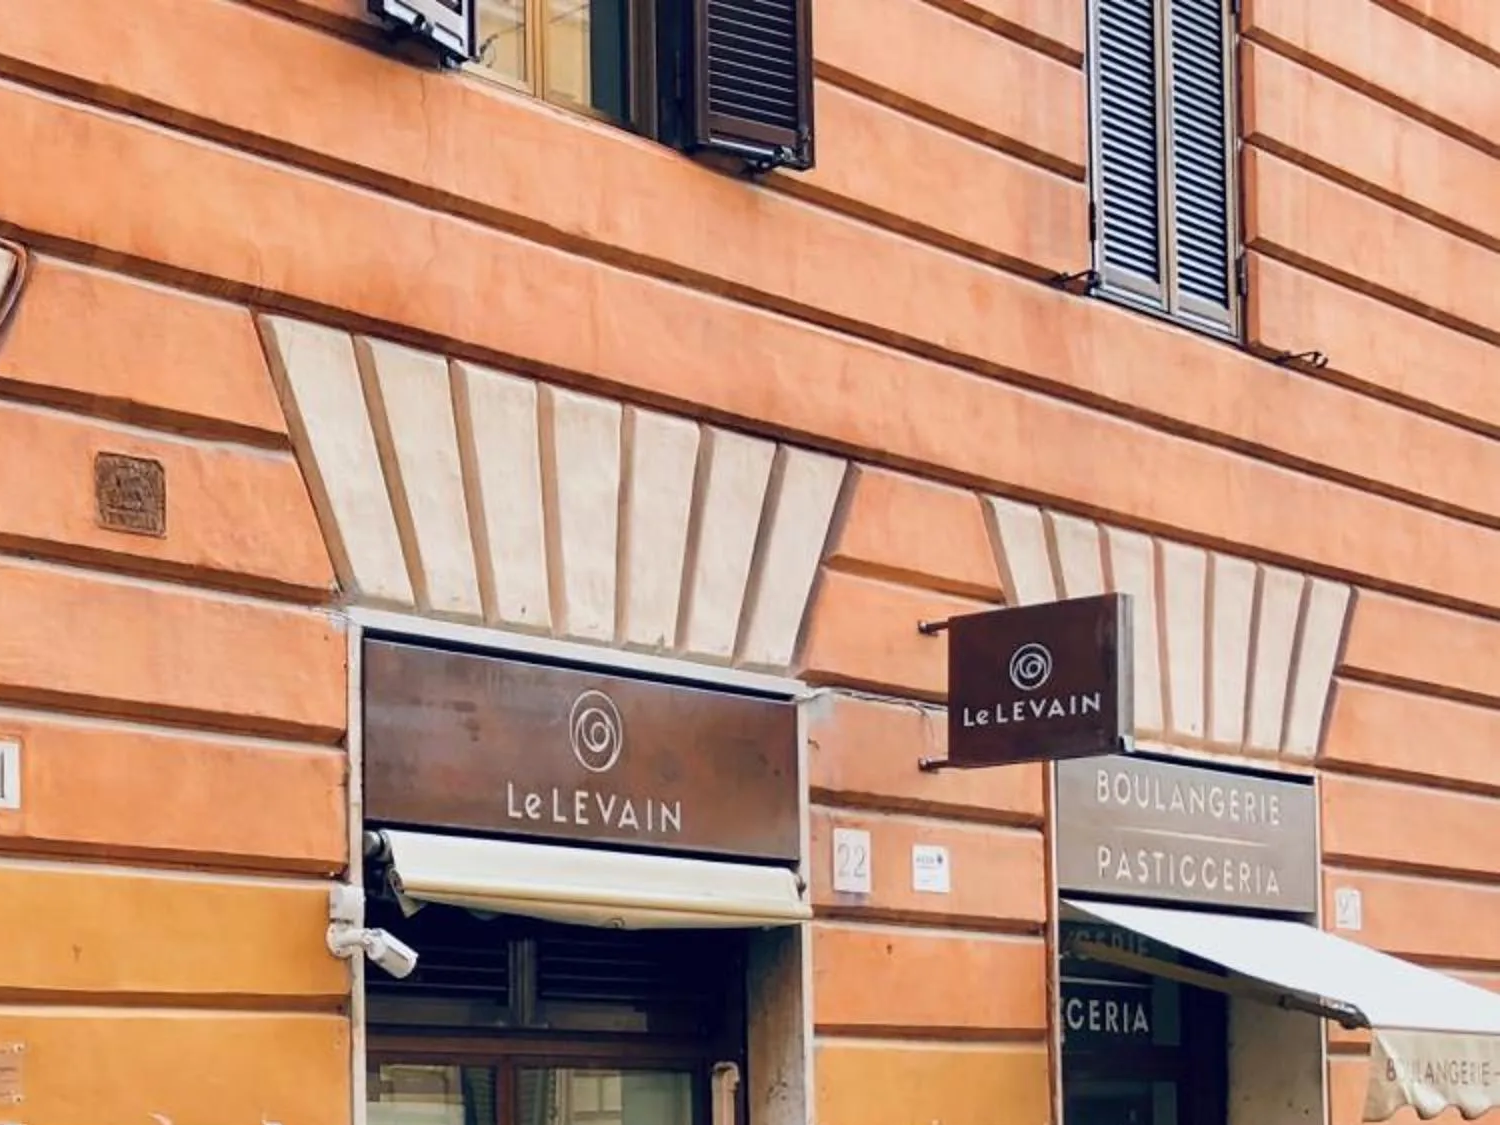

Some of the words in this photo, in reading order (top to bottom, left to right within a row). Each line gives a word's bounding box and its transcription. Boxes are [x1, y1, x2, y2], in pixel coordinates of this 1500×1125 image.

[1096, 769, 1282, 826] BOULANGERIE
[837, 842, 867, 878] 22
[1097, 846, 1281, 897] PASTICCERIA
[1060, 997, 1150, 1034] CERIA
